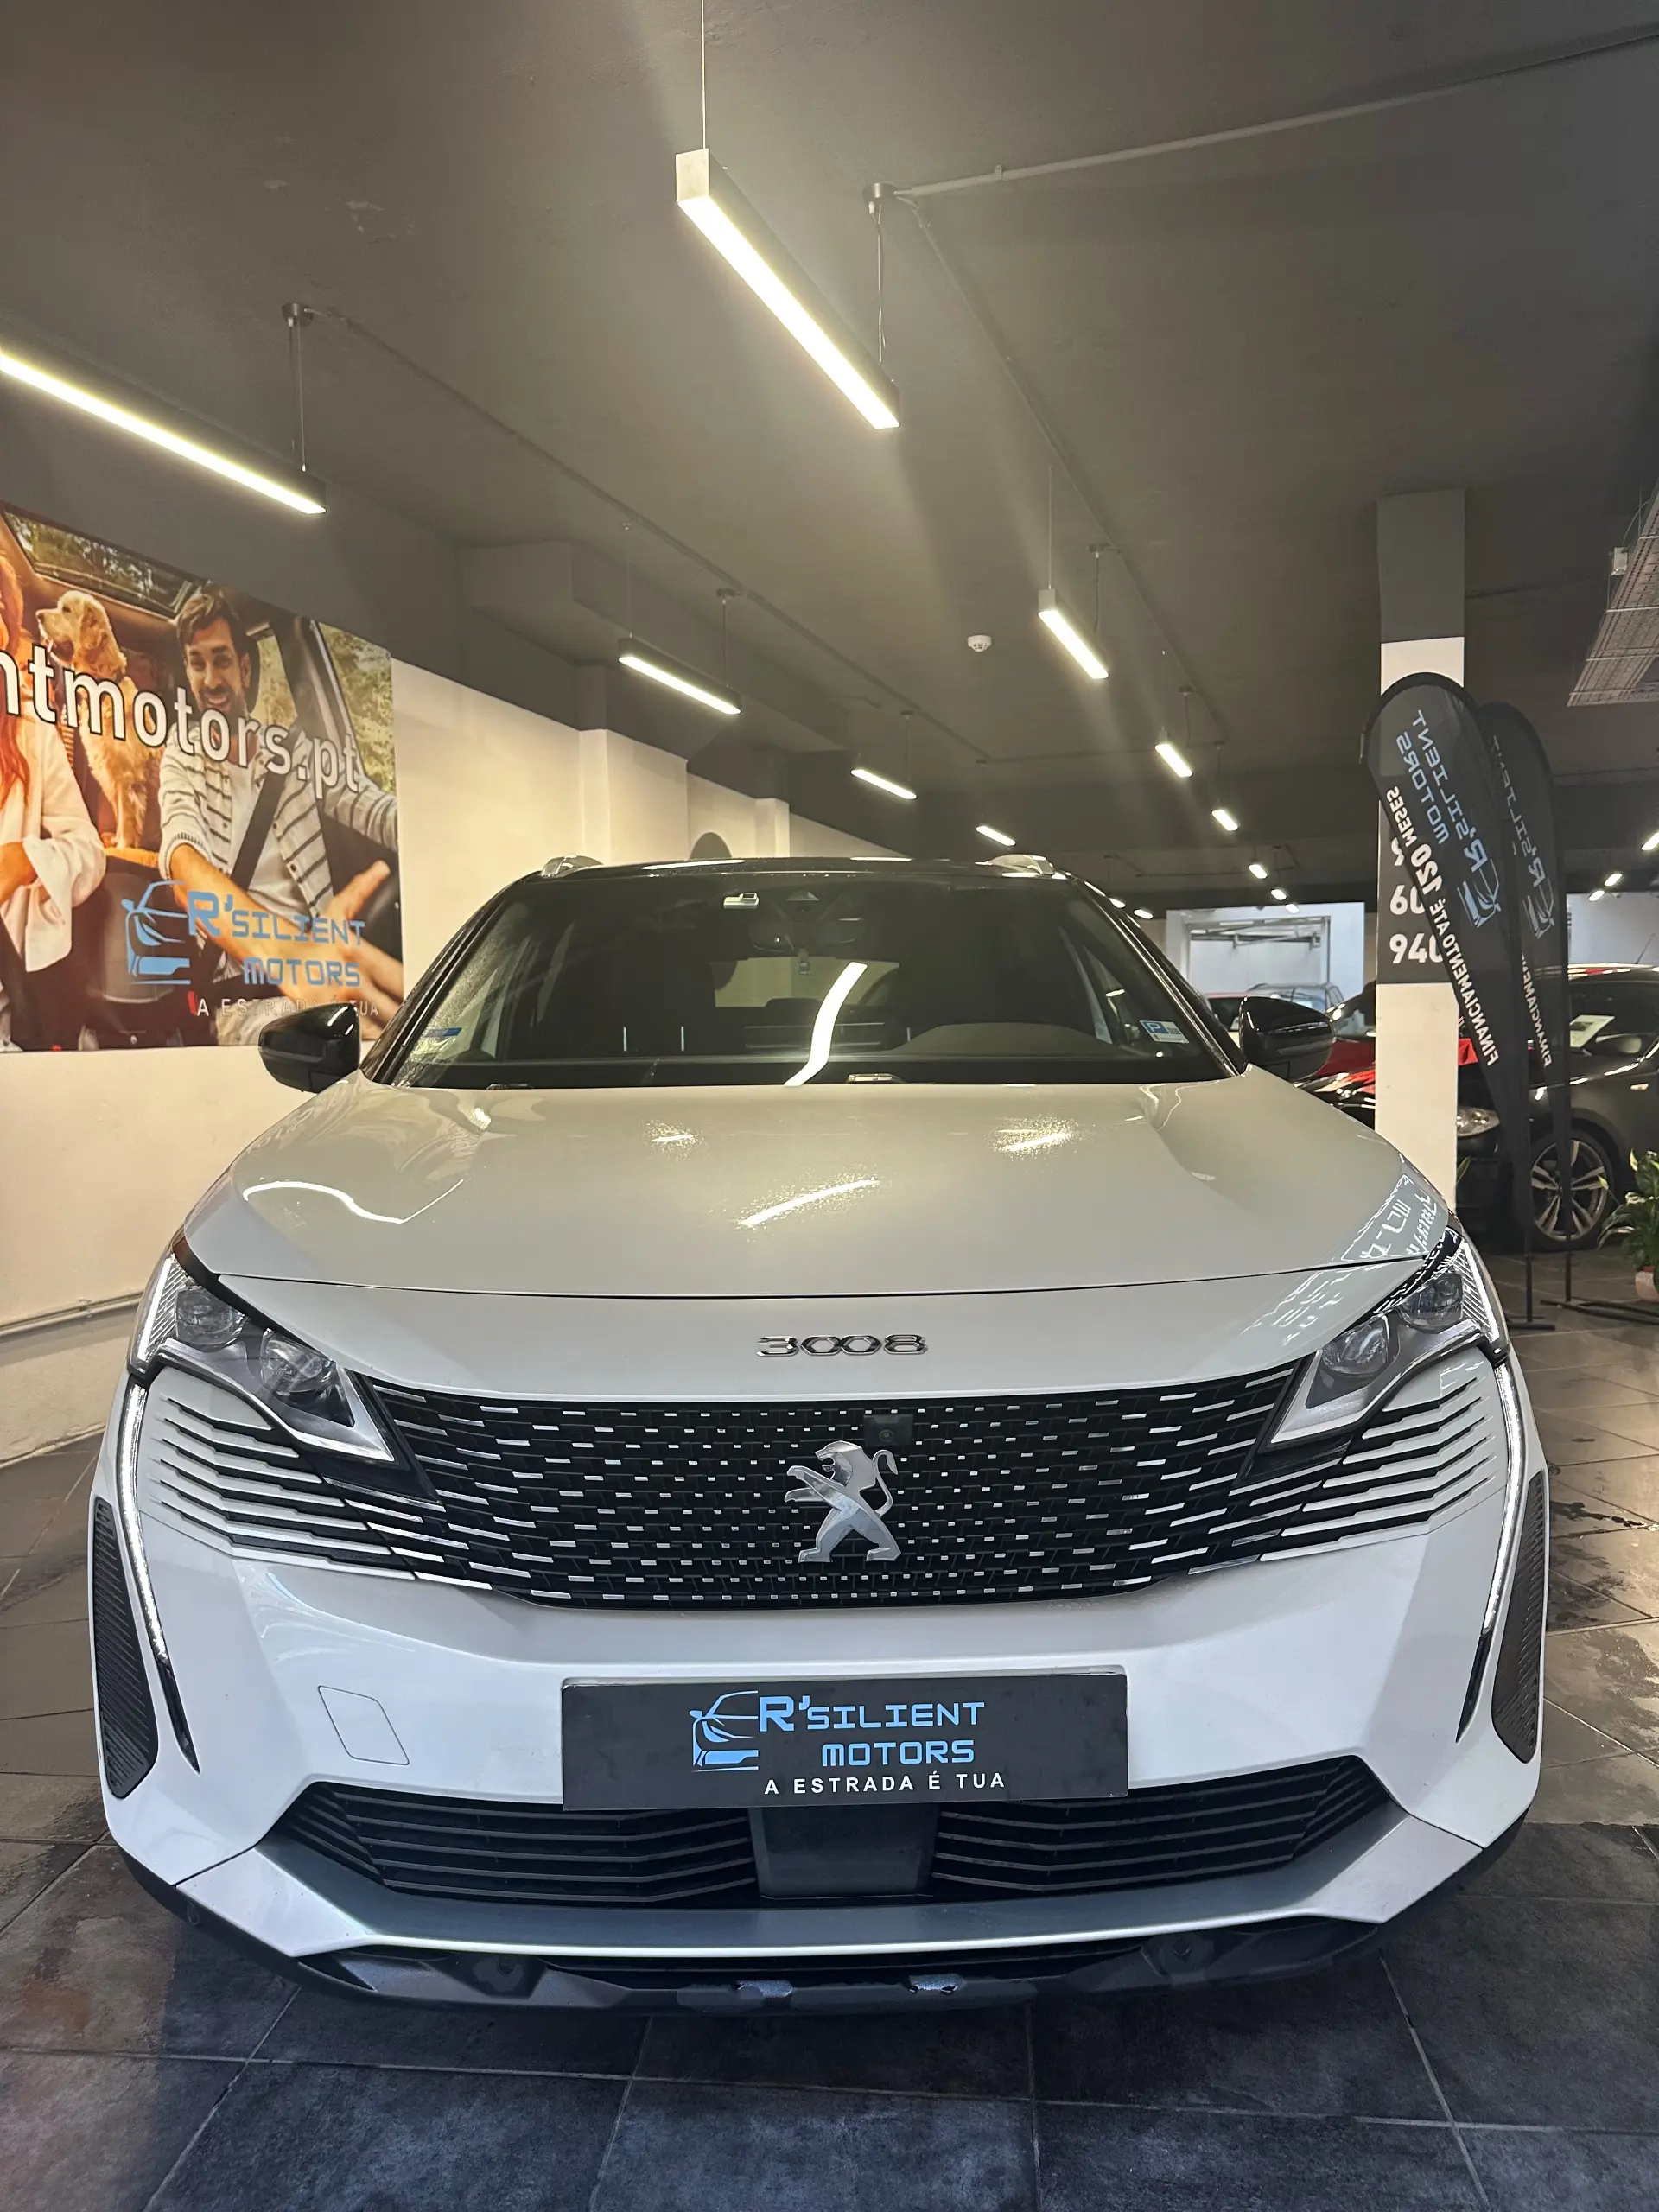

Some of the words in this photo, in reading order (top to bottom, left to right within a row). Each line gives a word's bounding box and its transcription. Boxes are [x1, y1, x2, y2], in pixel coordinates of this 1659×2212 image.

[243, 957, 360, 987] MOTORS
[197, 999, 209, 1016] A
[756, 1334, 928, 1357] 3008
[759, 1695, 985, 1732] R'SILIENT
[822, 1739, 975, 1767] MOTORS
[764, 1779, 779, 1795] A
[793, 1775, 914, 1794] ESTRADA
[928, 1771, 941, 1789] É
[956, 1773, 1005, 1789] TUA
